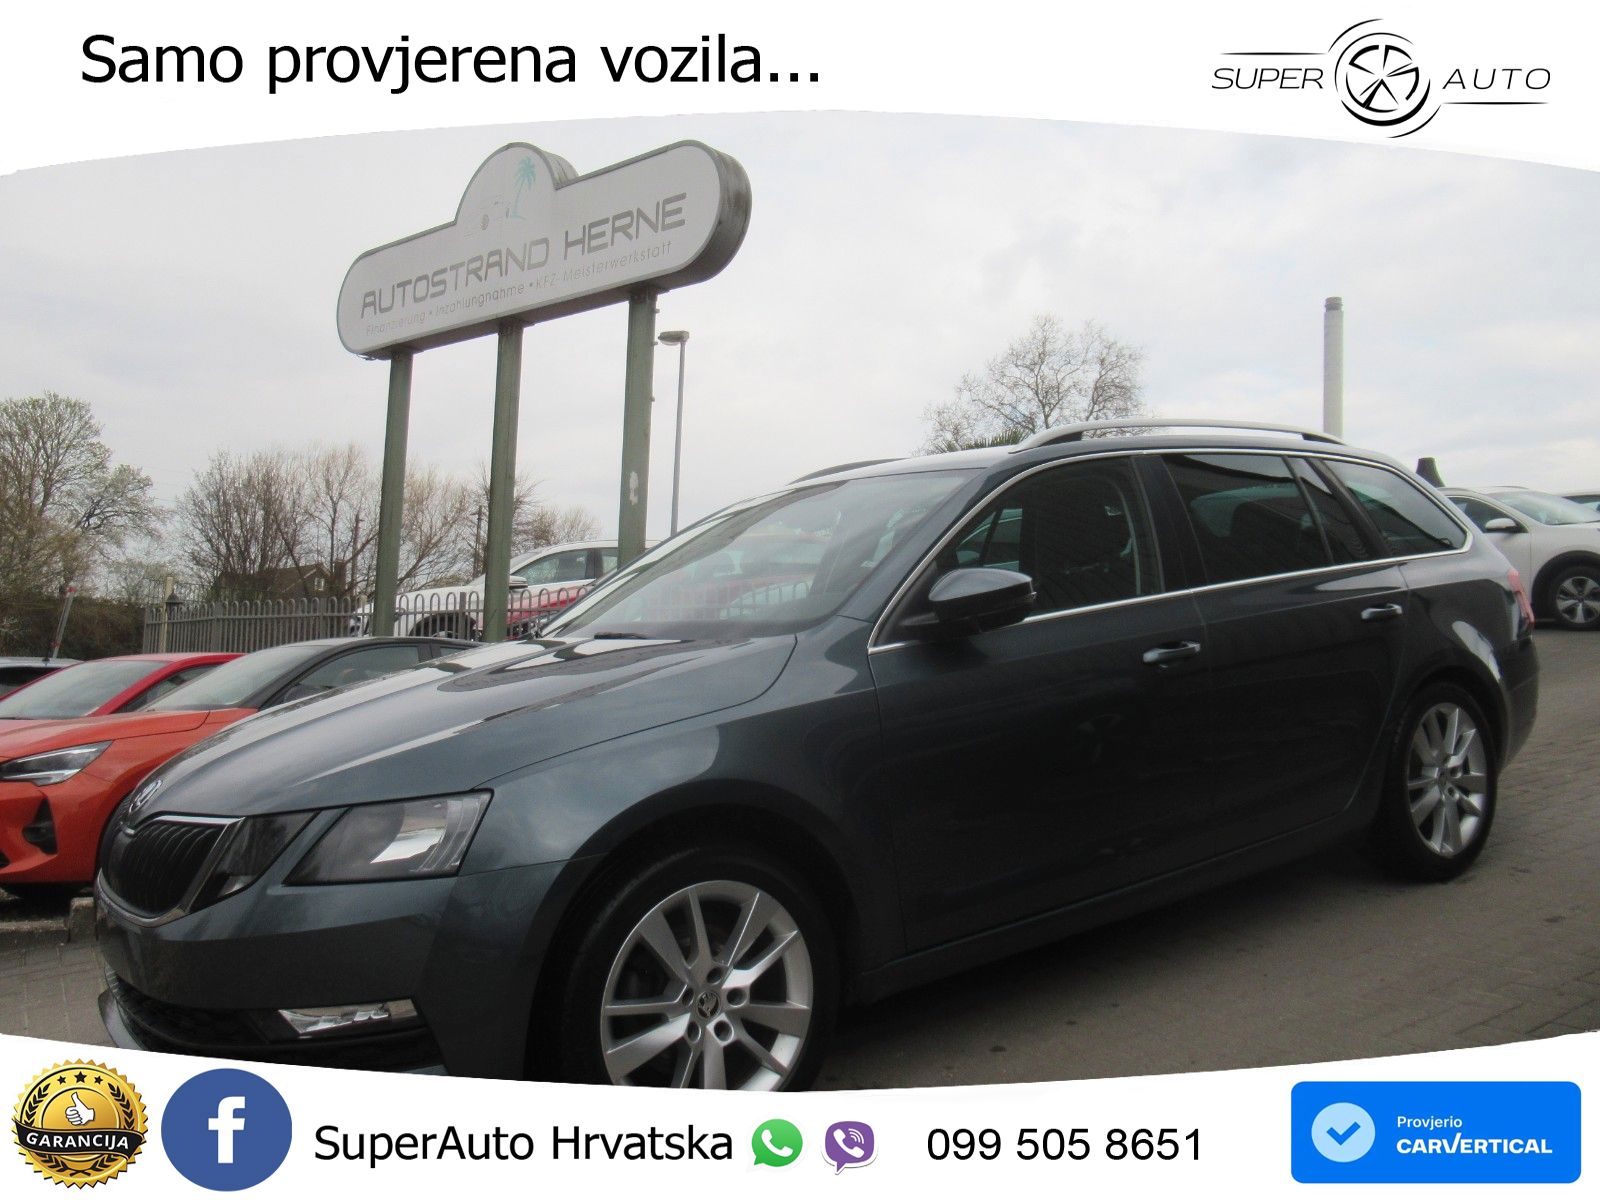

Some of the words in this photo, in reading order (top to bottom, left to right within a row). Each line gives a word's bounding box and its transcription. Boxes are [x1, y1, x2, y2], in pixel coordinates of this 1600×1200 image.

[360, 237, 550, 319] AUTOSTRAND
[563, 192, 687, 261] HERNE
[435, 282, 525, 317] Inzahlungnahme
